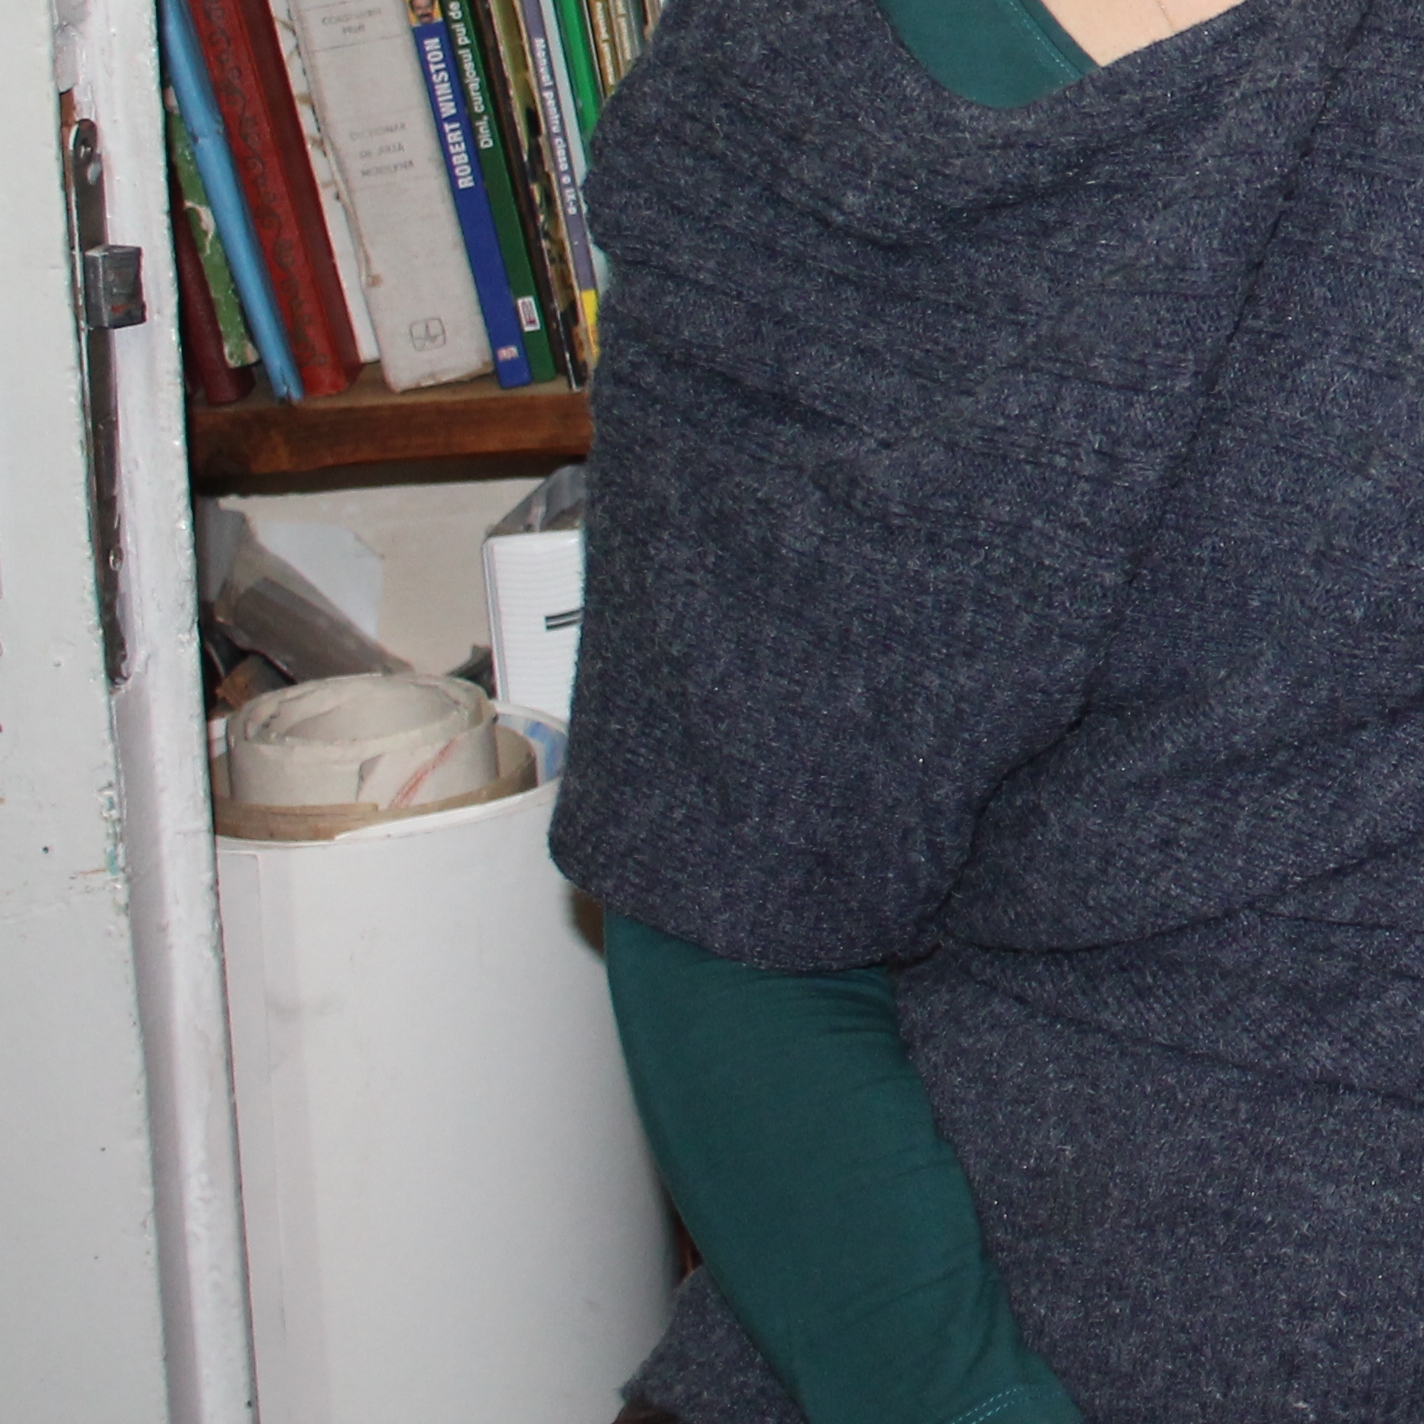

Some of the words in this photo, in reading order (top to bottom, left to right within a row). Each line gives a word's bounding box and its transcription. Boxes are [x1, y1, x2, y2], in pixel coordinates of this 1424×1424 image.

[447, 0, 464, 20] de
[451, 21, 472, 45] pui
[422, 36, 458, 119] WINSTON
[459, 47, 486, 113] curajosul
[532, 37, 553, 89] Manual
[474, 114, 493, 149] Dini,
[540, 91, 564, 134] pentru
[443, 120, 475, 189] ROBERT
[551, 137, 569, 172] clasa
